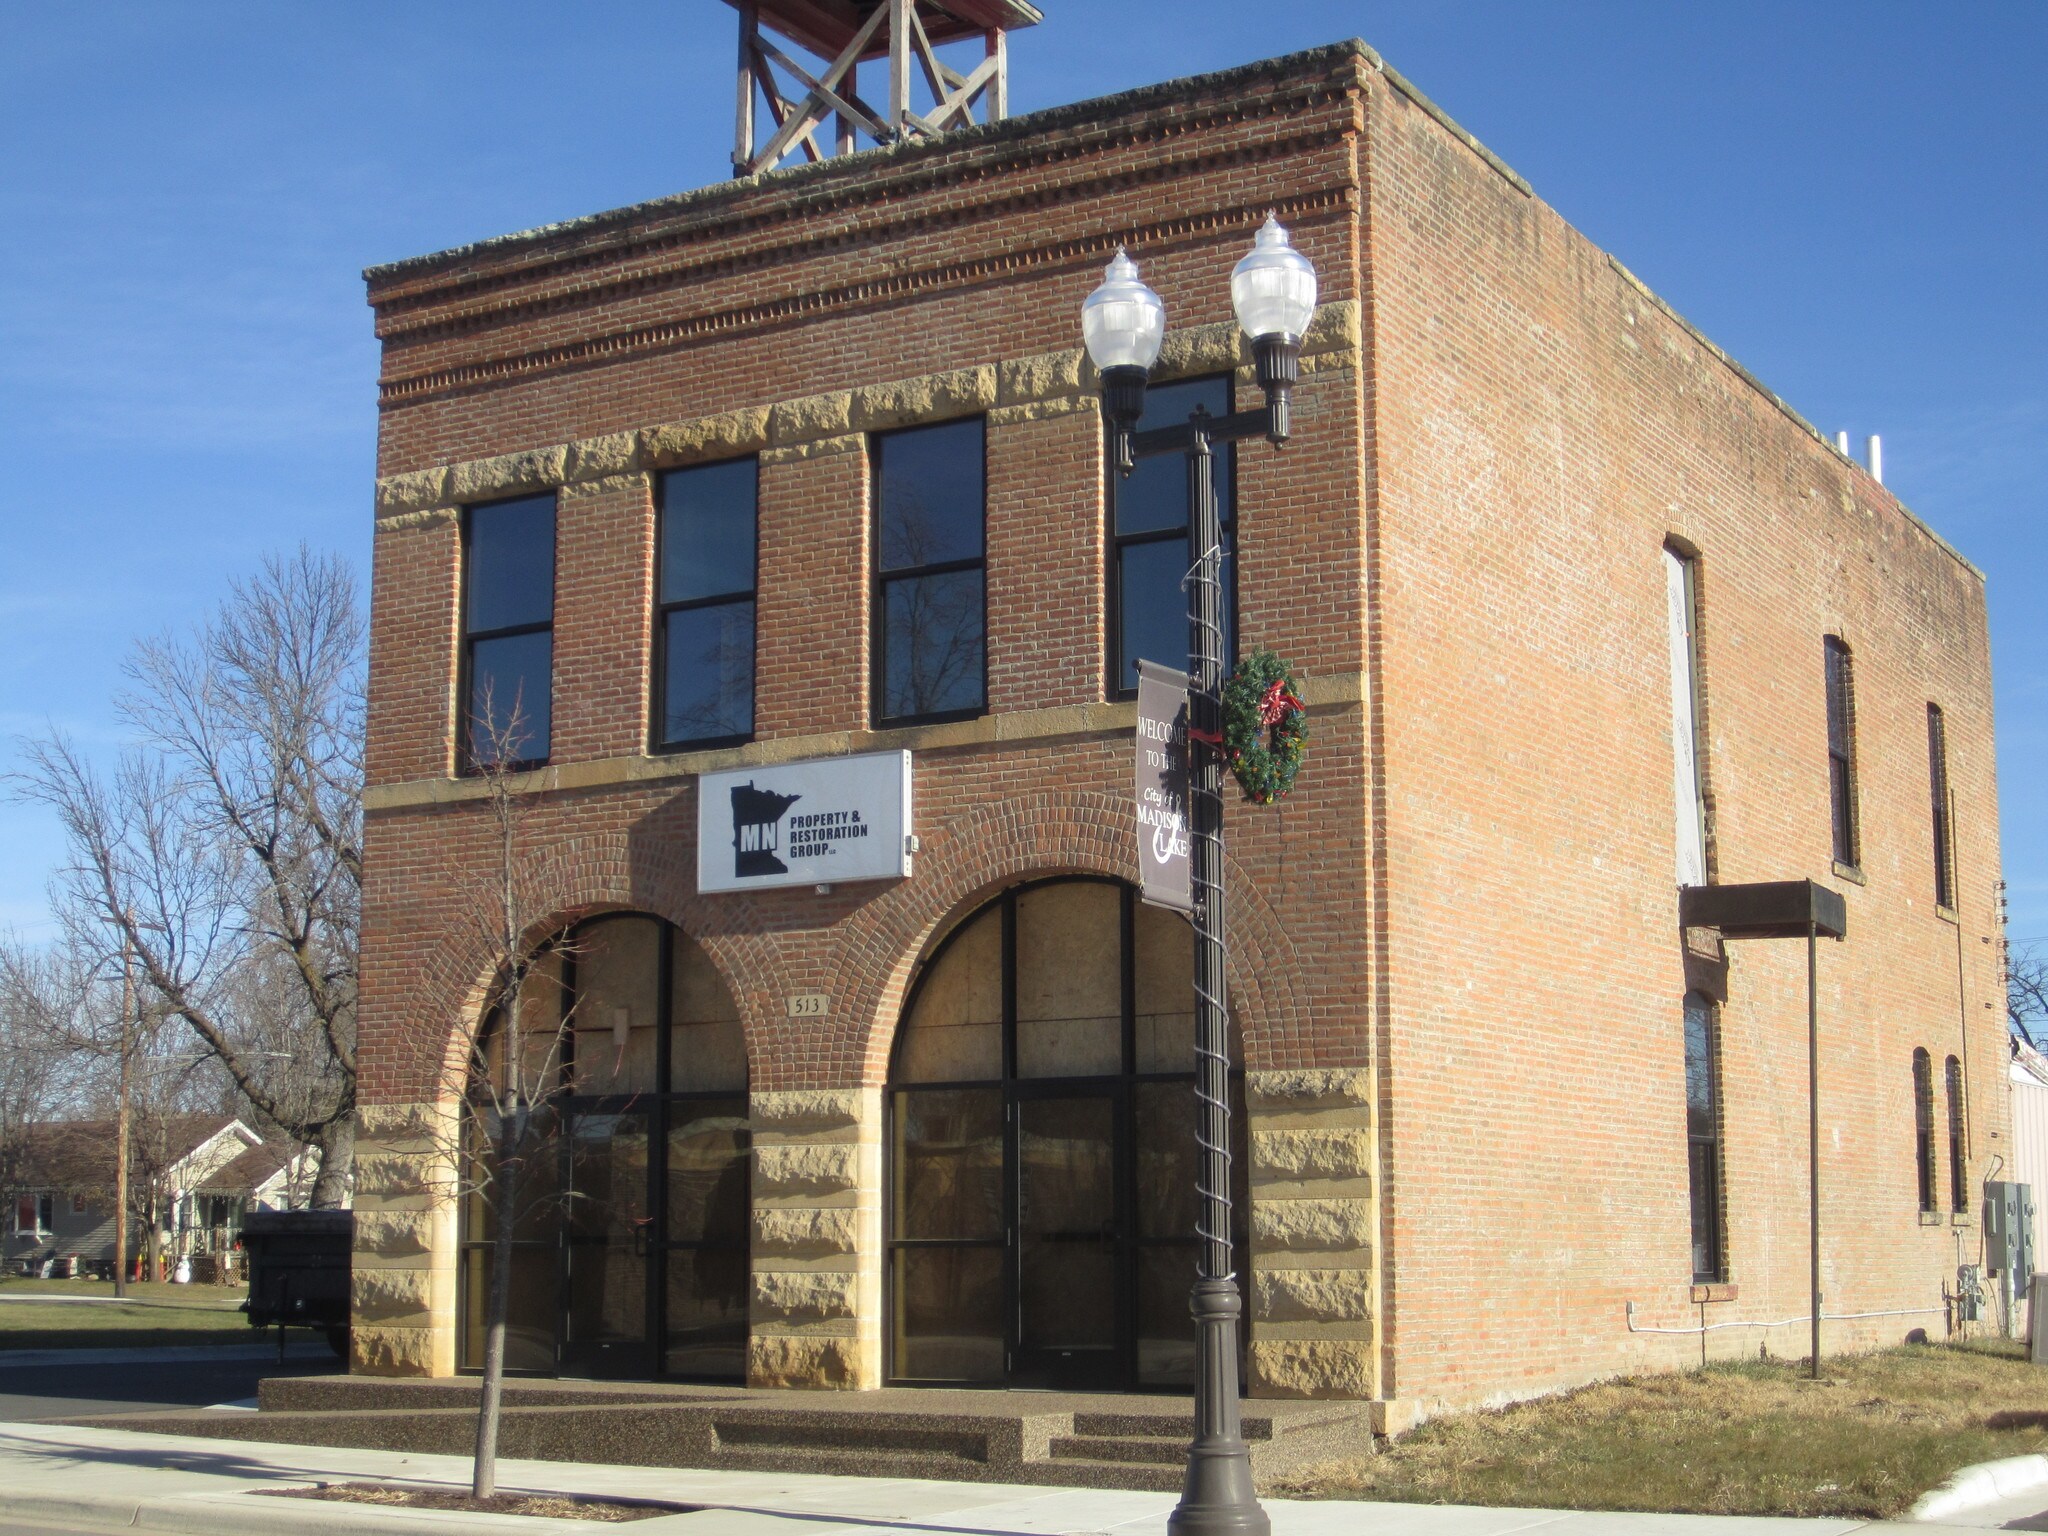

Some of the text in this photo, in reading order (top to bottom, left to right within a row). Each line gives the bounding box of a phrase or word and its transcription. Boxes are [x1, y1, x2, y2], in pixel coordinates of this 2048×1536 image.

[1138, 716, 1186, 746] WELCOME
[1146, 749, 1177, 771] TO THE
[1144, 787, 1173, 807] City of
[790, 810, 861, 829] PROPERTY &
[1137, 803, 1187, 833] MADISON
[740, 822, 776, 852] MN
[790, 824, 868, 843] RESTORATION
[790, 843, 829, 858] GROUP
[1159, 832, 1188, 857] LAKE
[796, 998, 819, 1013] 513
